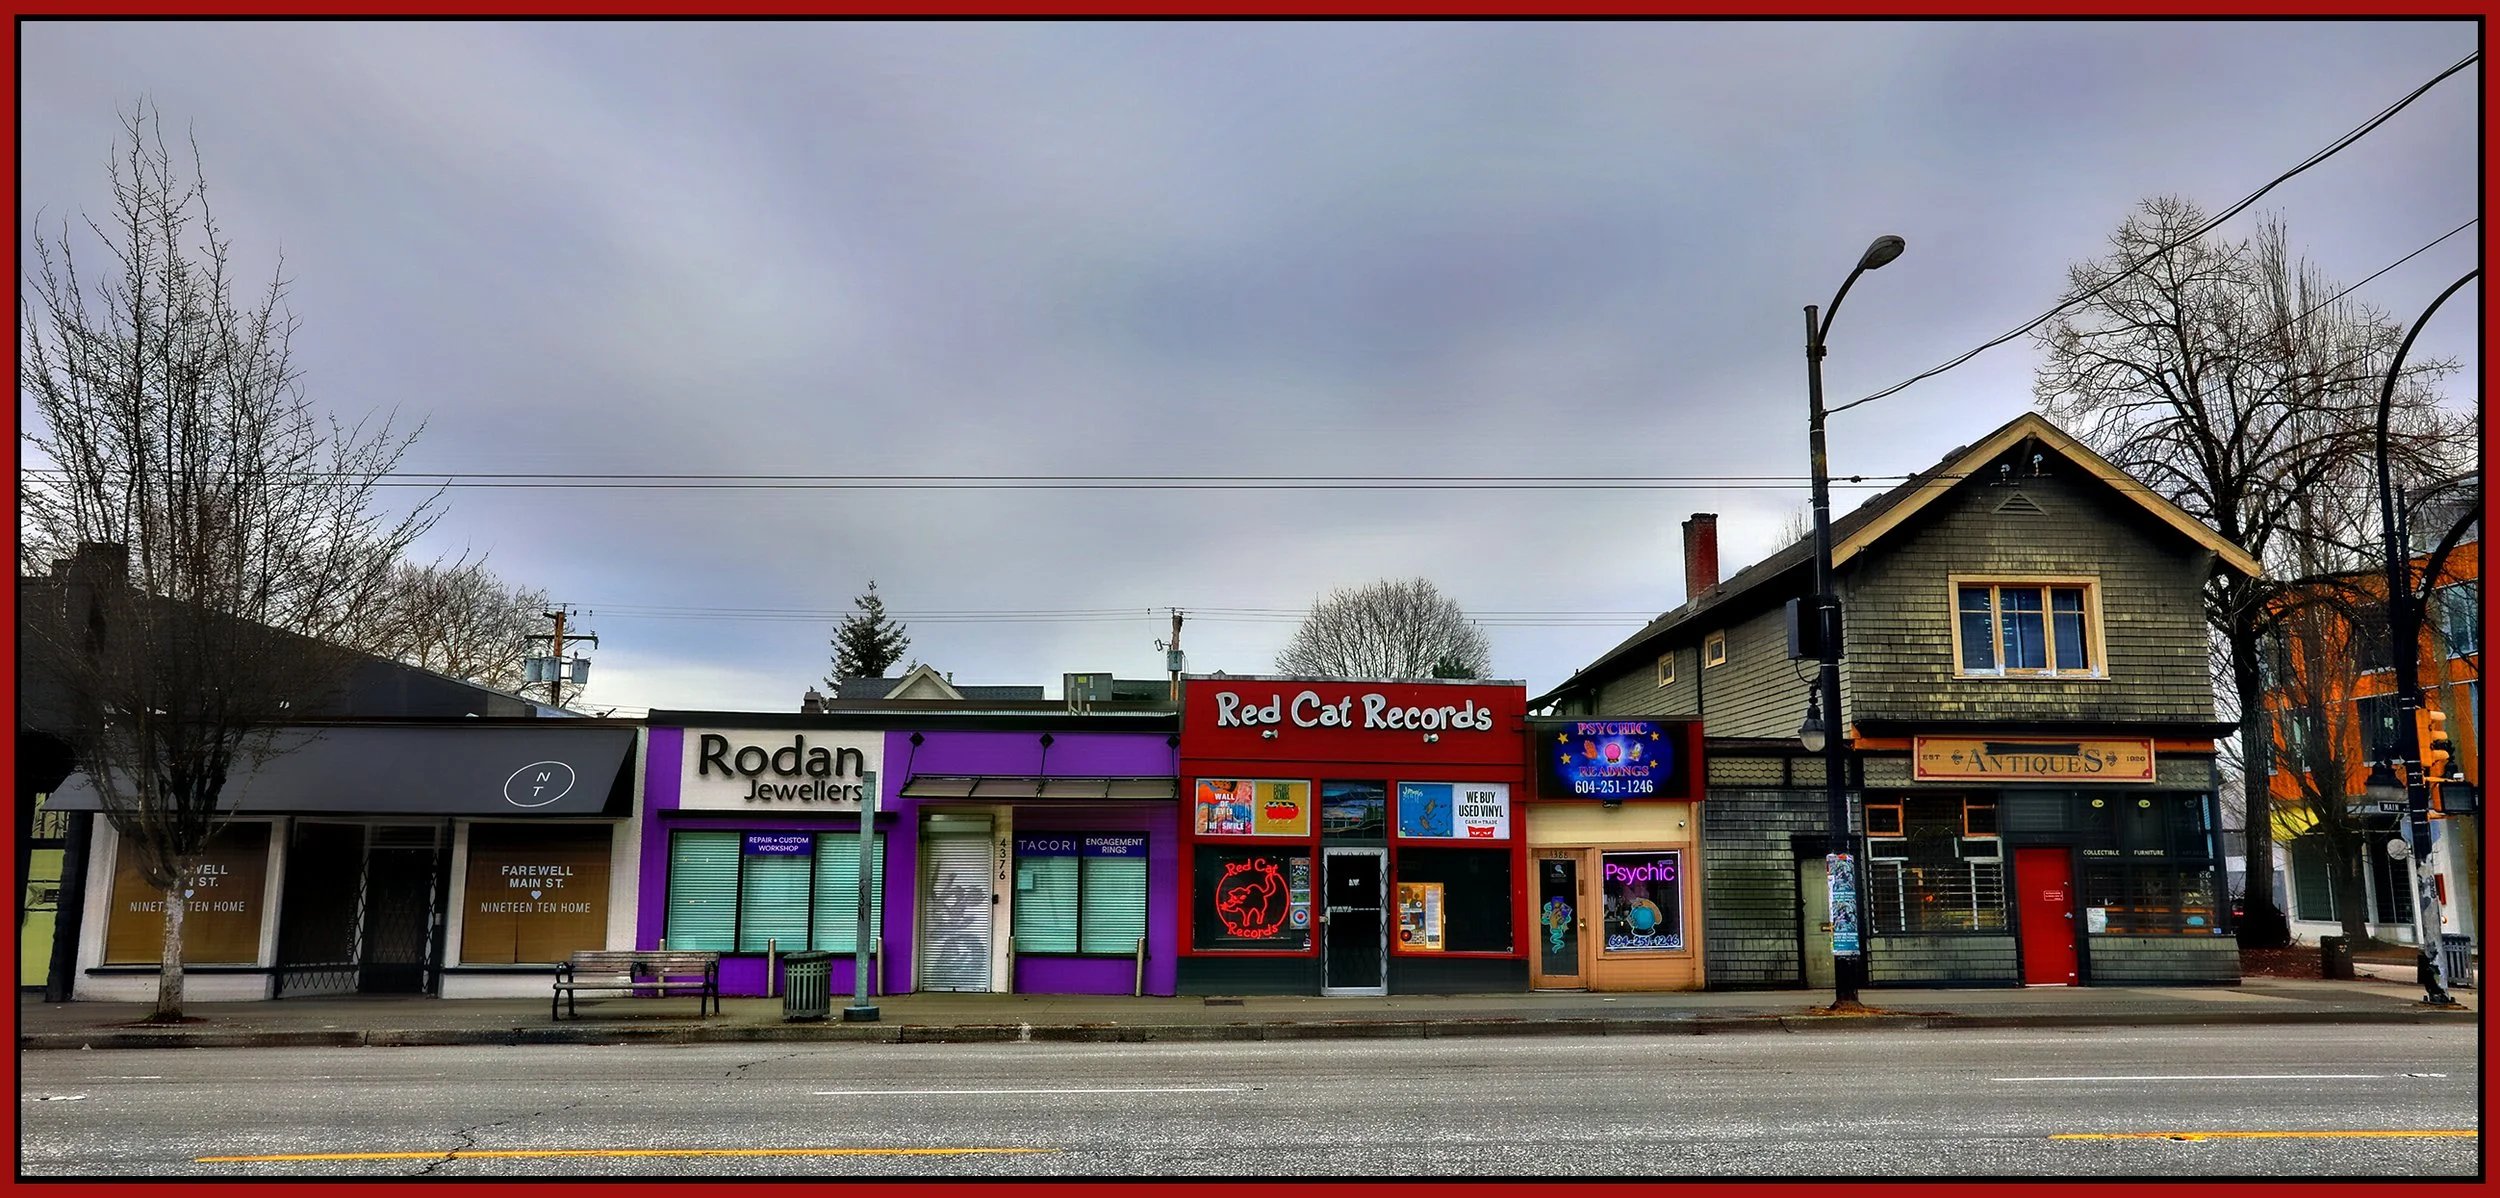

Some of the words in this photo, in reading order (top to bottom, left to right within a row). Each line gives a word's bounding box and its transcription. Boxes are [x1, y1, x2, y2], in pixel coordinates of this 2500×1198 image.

[1215, 691, 1281, 728] Red
[1291, 690, 1352, 728] Cat
[1361, 693, 1493, 731] Records
[1577, 722, 1648, 735] PSYCHIC
[699, 734, 864, 778] Rodan
[1966, 748, 2104, 774] ANTIQUES
[536, 772, 551, 782] N
[1579, 766, 1650, 777] READINGS
[533, 786, 544, 797] T
[744, 779, 863, 801] Jewellers
[1575, 780, 1654, 794] 604-251-1246
[1214, 793, 1236, 801] WALL
[1466, 791, 1479, 804] WE
[1480, 791, 1496, 804] BUY
[1458, 804, 1479, 818] USED
[1480, 805, 1504, 818] VINYL
[2383, 803, 2400, 811] MAIN
[1222, 822, 1245, 830] SMILE
[749, 836, 773, 844] REPAIR
[778, 836, 809, 845] CUSTOM
[1018, 840, 1076, 851] TACORI
[1085, 838, 1144, 846] ENGAGEMENT
[758, 844, 799, 852] WORKSHOP
[1101, 846, 1127, 854] RINGS
[999, 838, 1007, 880] 4376
[501, 865, 574, 876] FAREWELL
[1225, 858, 1251, 876] Red
[1254, 858, 1279, 875] Cat
[1605, 863, 1675, 886] Psychic
[198, 877, 219, 887] ST.
[509, 878, 541, 888] MAIN
[545, 878, 564, 888] ST.
[130, 901, 166, 912] NINET
[189, 901, 209, 912] TEN
[213, 901, 245, 912] HOME
[480, 902, 533, 913] NINETEEN
[537, 902, 557, 913] TEN
[560, 902, 591, 913] HOME
[1227, 922, 1280, 939] Records
[1608, 933, 1680, 947] 604-251-1246
